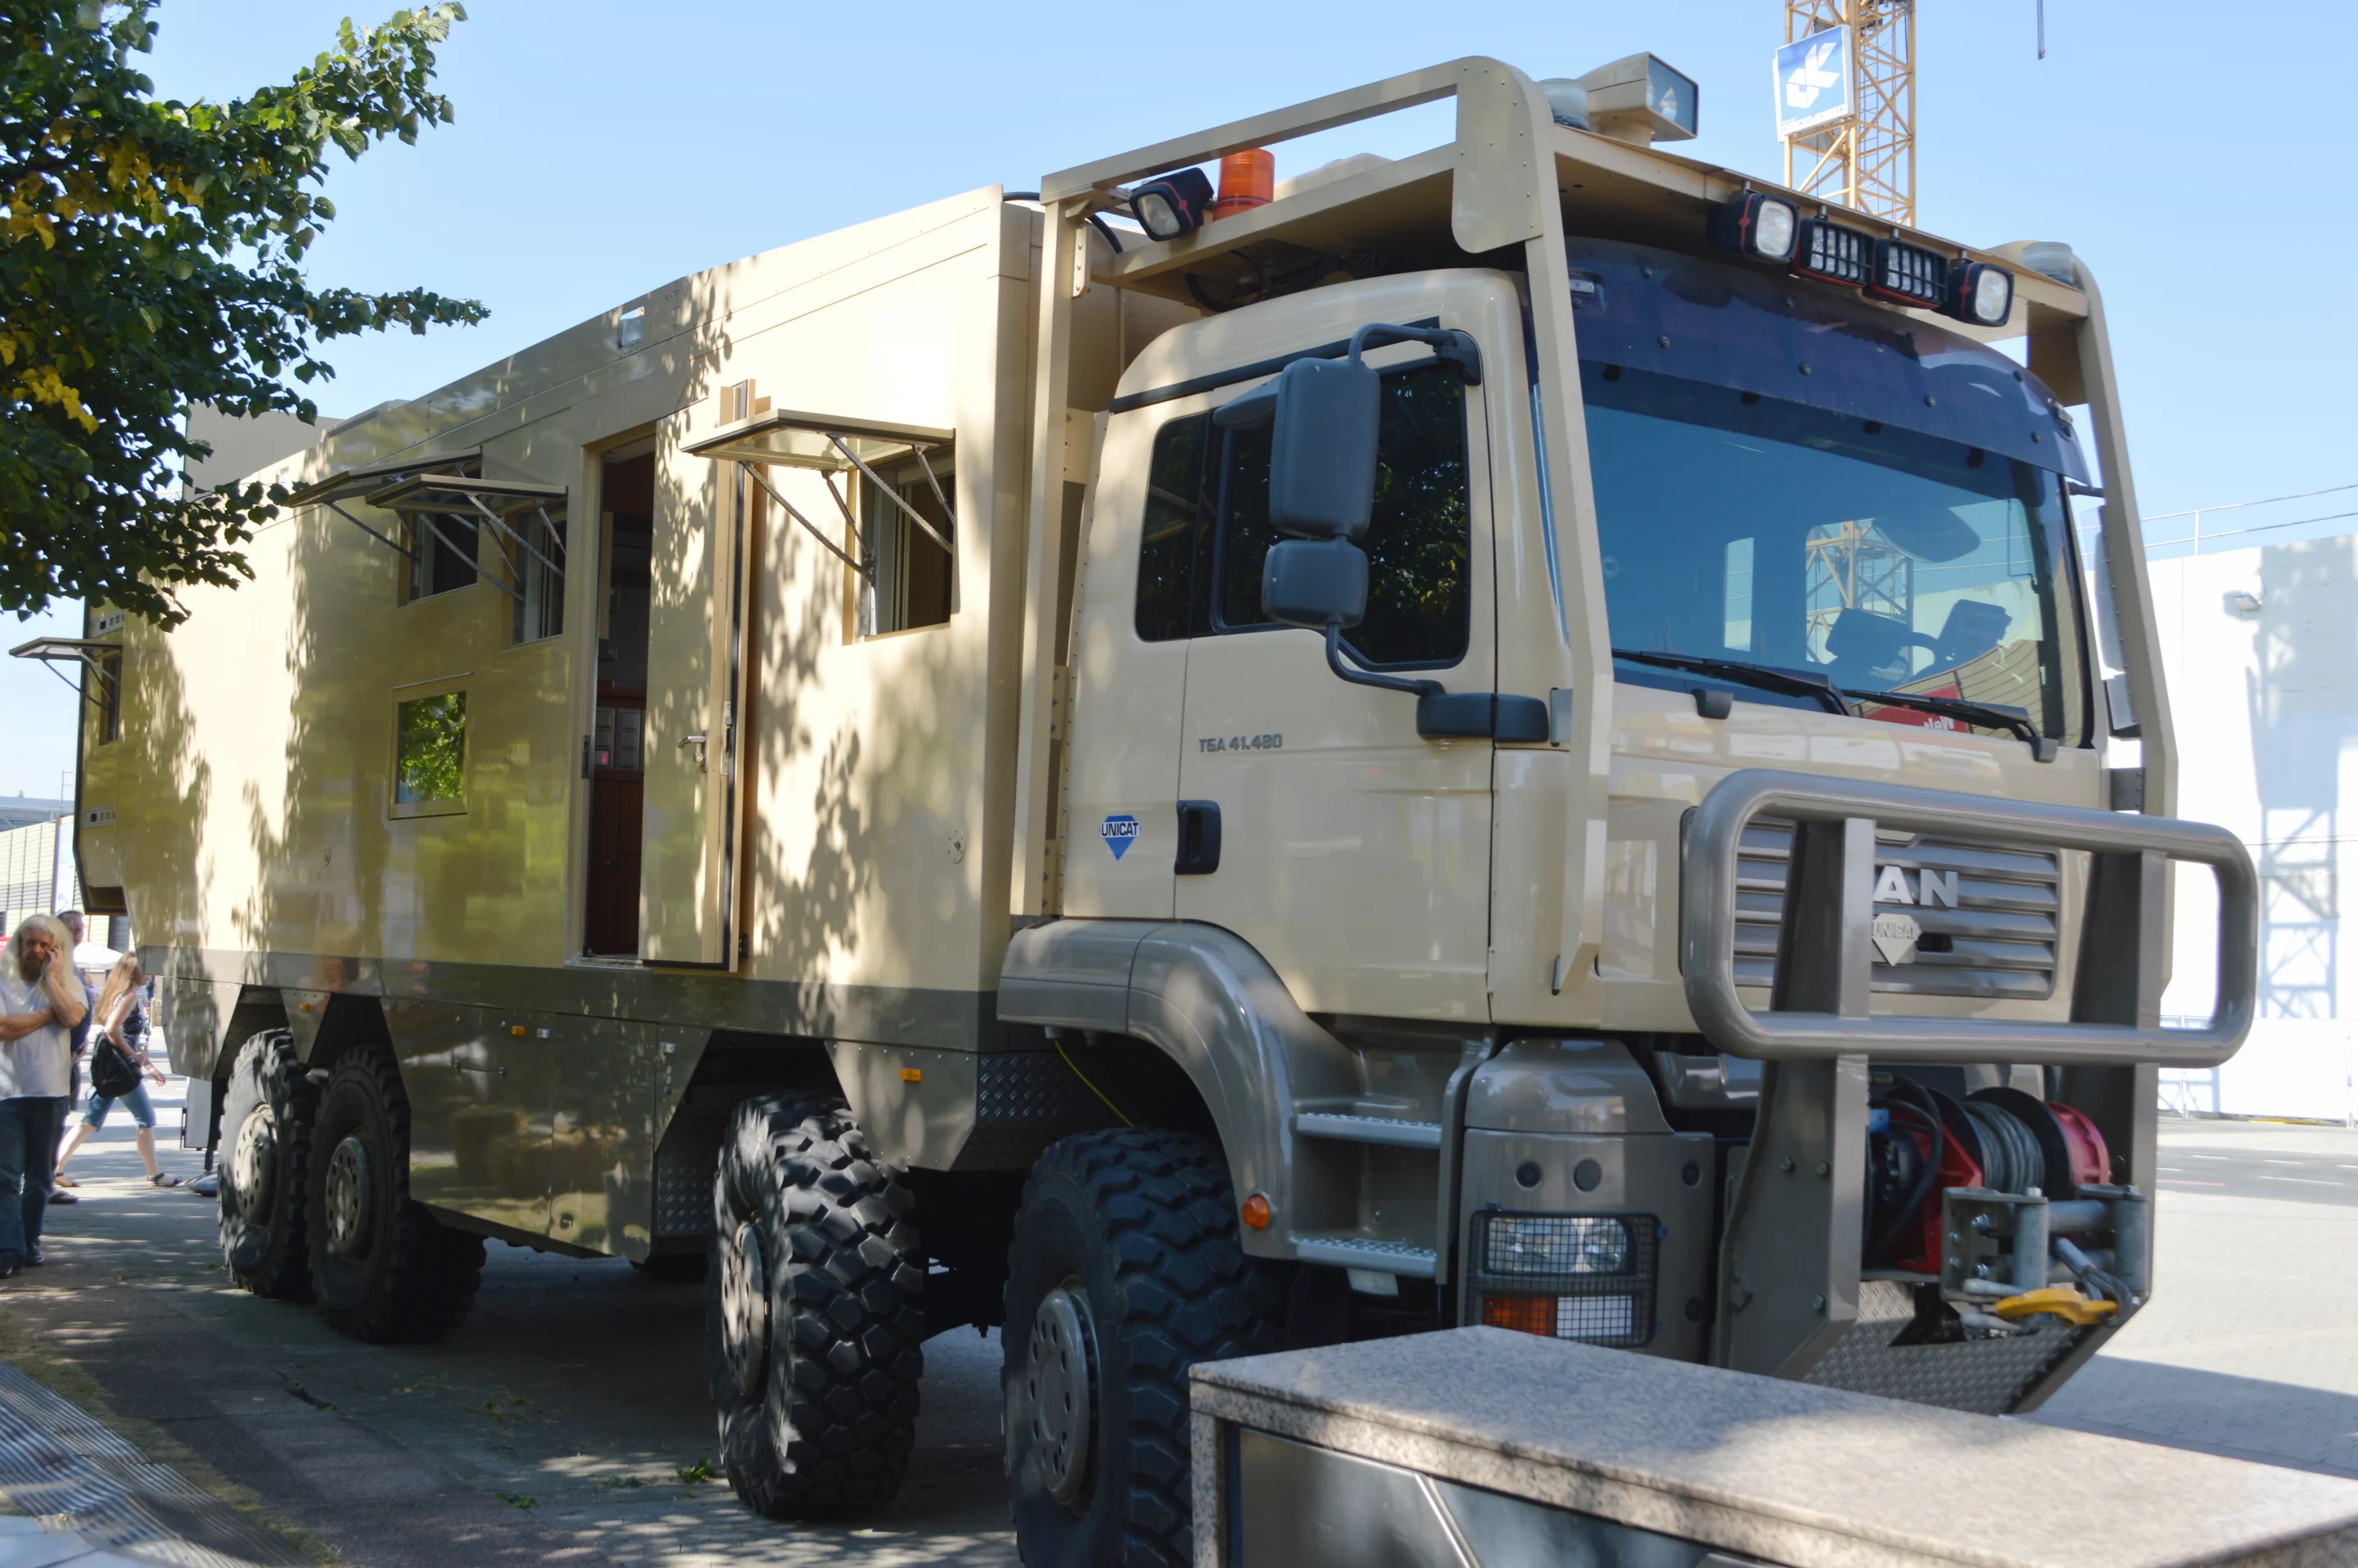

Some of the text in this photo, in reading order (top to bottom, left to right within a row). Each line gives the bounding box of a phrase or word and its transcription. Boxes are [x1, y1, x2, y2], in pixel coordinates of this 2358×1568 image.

[1199, 733, 1284, 752] TGA 41.480
[1101, 822, 1139, 837] UNICAT
[1872, 865, 1958, 908] AN
